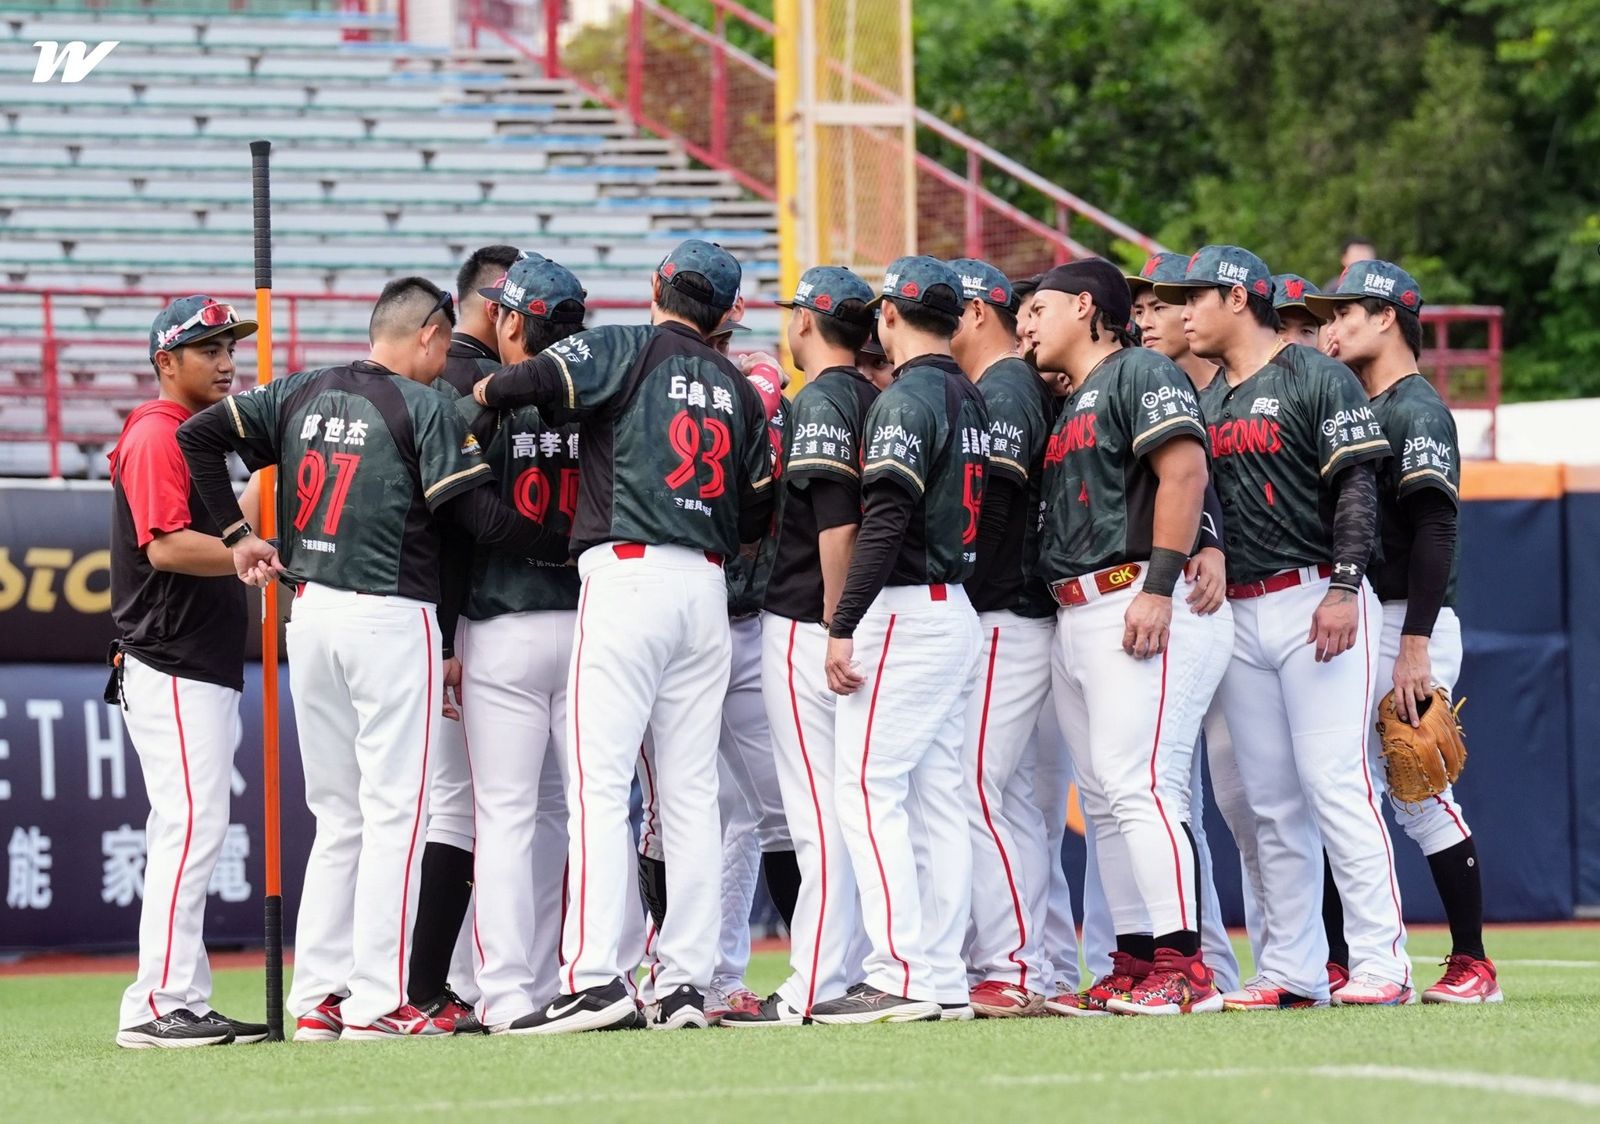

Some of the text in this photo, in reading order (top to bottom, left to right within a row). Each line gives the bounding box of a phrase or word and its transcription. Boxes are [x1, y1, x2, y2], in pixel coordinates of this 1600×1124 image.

[300, 413, 369, 446] 邱世杰
[664, 409, 731, 498] 93
[790, 439, 851, 460] 王道銀行
[293, 448, 362, 536] 97
[1109, 566, 1134, 585] GK
[1071, 585, 1080, 597] 4
